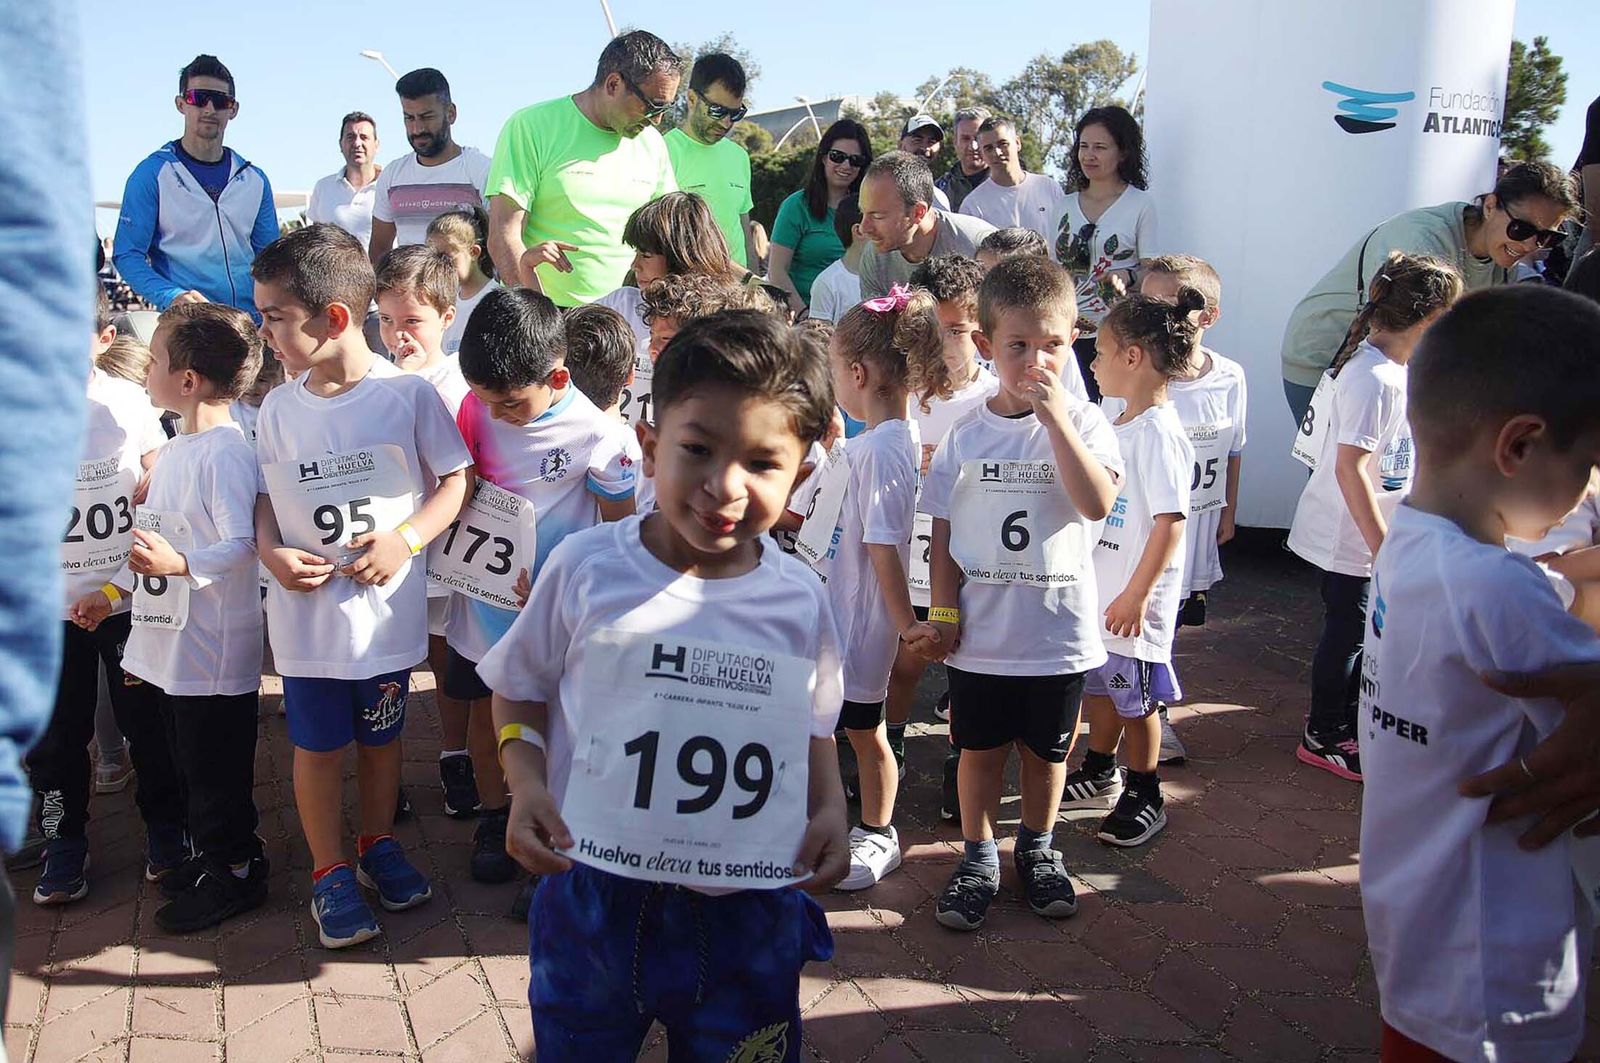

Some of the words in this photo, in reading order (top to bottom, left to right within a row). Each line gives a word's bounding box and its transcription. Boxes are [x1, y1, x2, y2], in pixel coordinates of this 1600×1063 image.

[338, 458, 375, 471] HUELVA
[1018, 471, 1054, 479] HUELVA
[489, 492, 520, 512] HUELVA
[63, 495, 133, 543] 203
[313, 497, 376, 545] 95
[1001, 510, 1030, 552] 6
[442, 519, 515, 575] 173
[443, 575, 465, 588] eleva
[466, 583, 480, 595] tus
[992, 569, 1017, 580] eleva
[1019, 571, 1034, 581] tus
[651, 643, 686, 673] H
[692, 647, 775, 673] DIPUTACIÓN
[689, 675, 745, 692] OBJETIVOS
[691, 662, 711, 677] DE
[717, 666, 773, 686] HUELVA
[624, 730, 774, 820] 199
[579, 838, 642, 868] Huelva
[645, 850, 694, 875] eleva
[697, 859, 721, 877] tus
